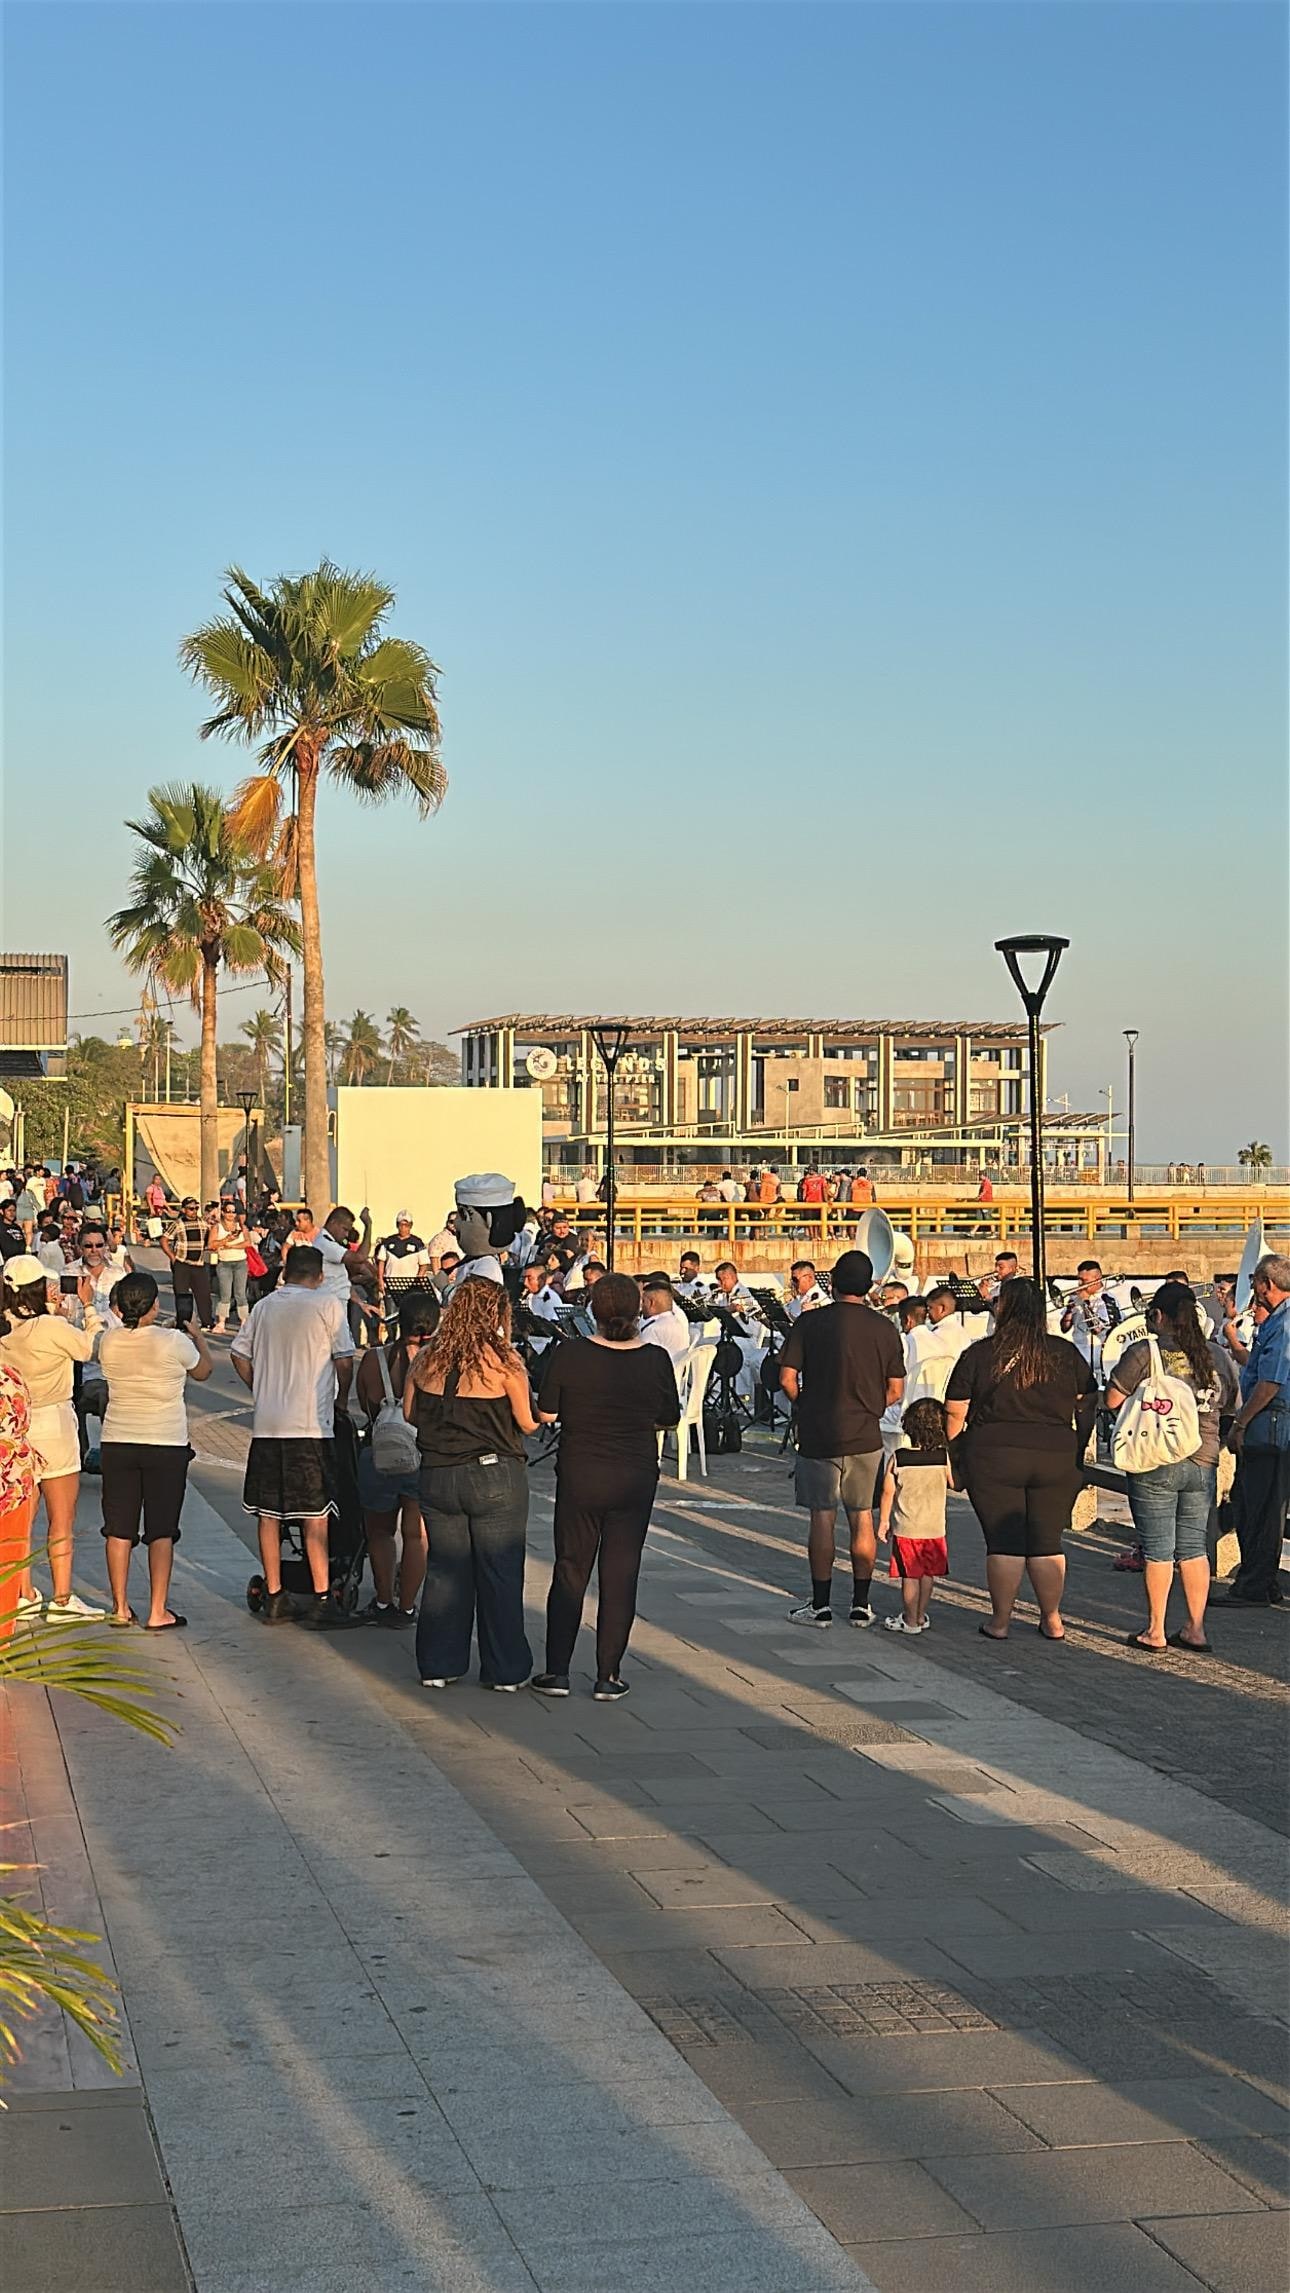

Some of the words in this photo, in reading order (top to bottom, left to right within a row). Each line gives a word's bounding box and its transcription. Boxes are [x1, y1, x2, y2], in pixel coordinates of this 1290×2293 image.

[566, 1057, 665, 1072] LEGNDS
[575, 1074, 589, 1083] AT
[625, 1074, 655, 1084] PIER
[1126, 1327, 1149, 1341] YAM
